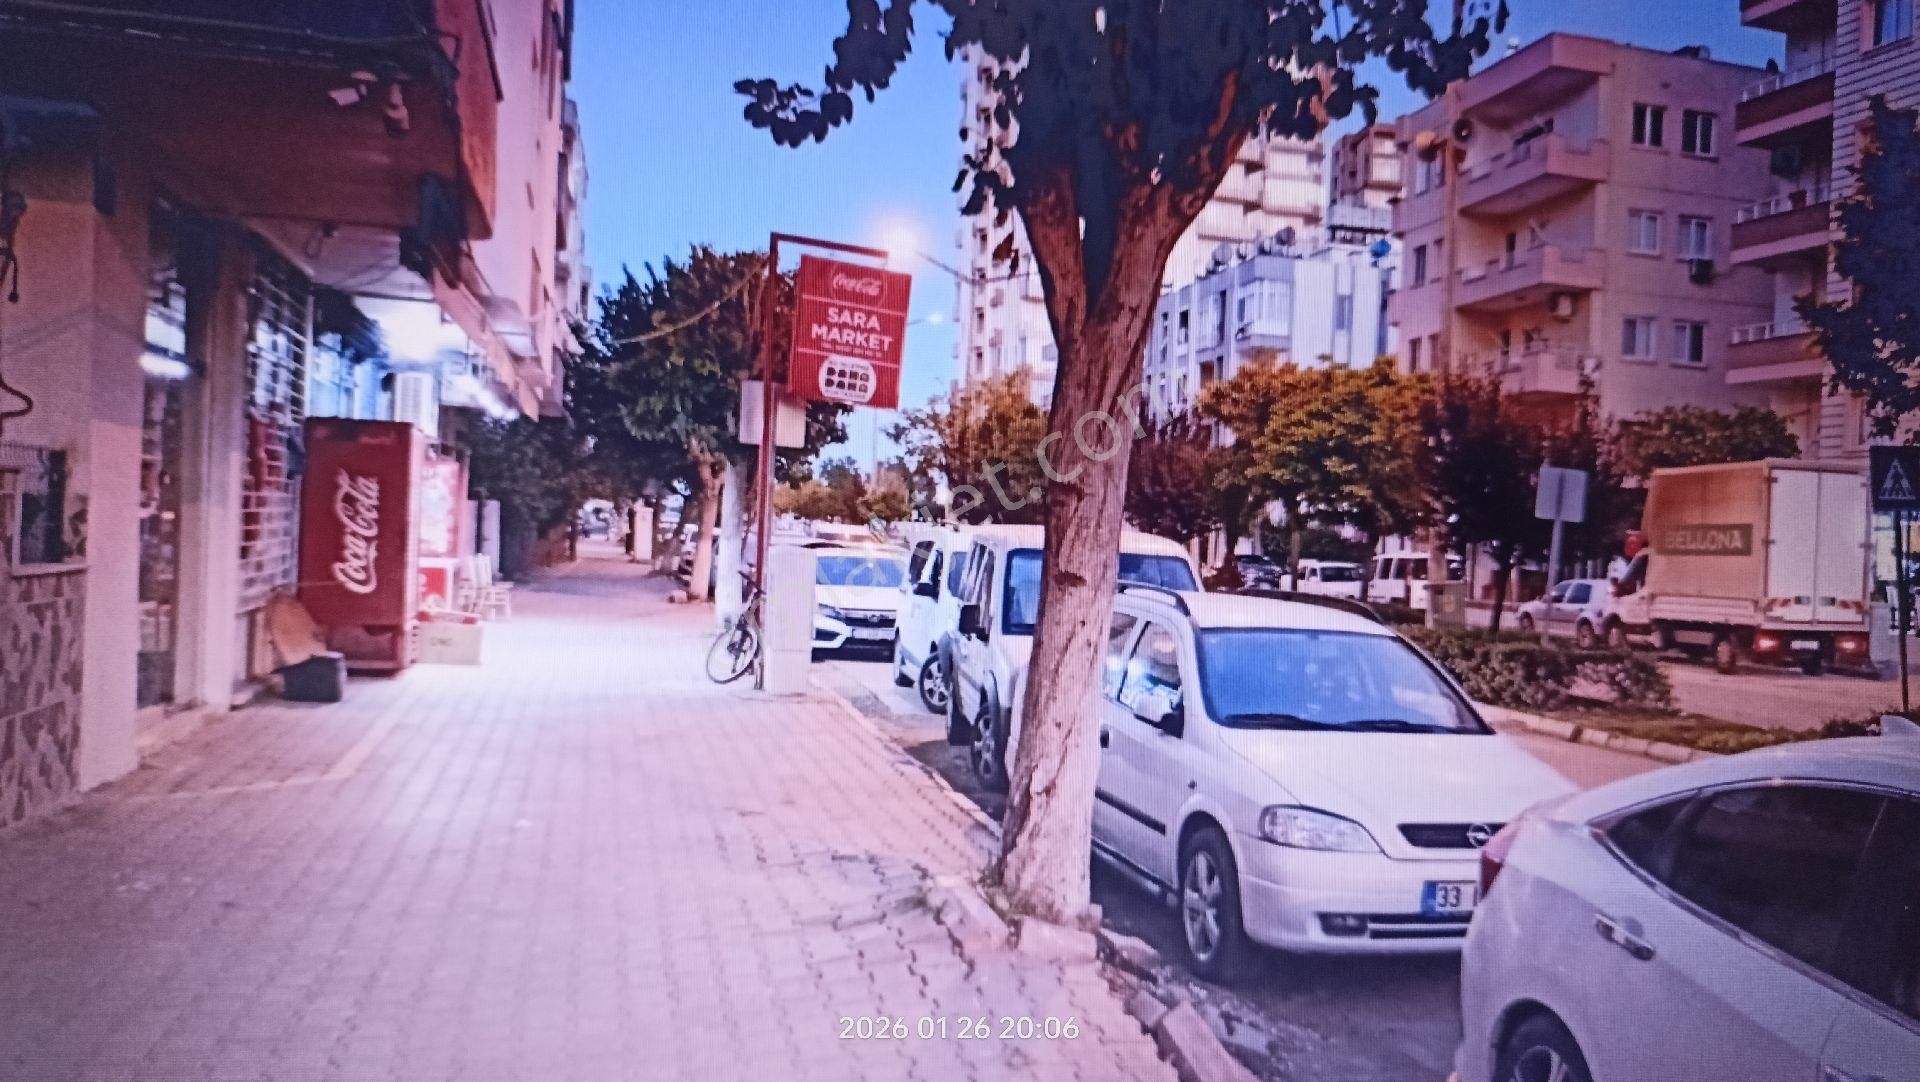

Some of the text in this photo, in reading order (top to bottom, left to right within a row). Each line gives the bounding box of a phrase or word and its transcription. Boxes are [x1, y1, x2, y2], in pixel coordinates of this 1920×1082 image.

[827, 307, 881, 332] SARA
[811, 323, 893, 352] MARKET
[1665, 529, 1743, 550] BELLONA
[1437, 885, 1462, 908] 33
